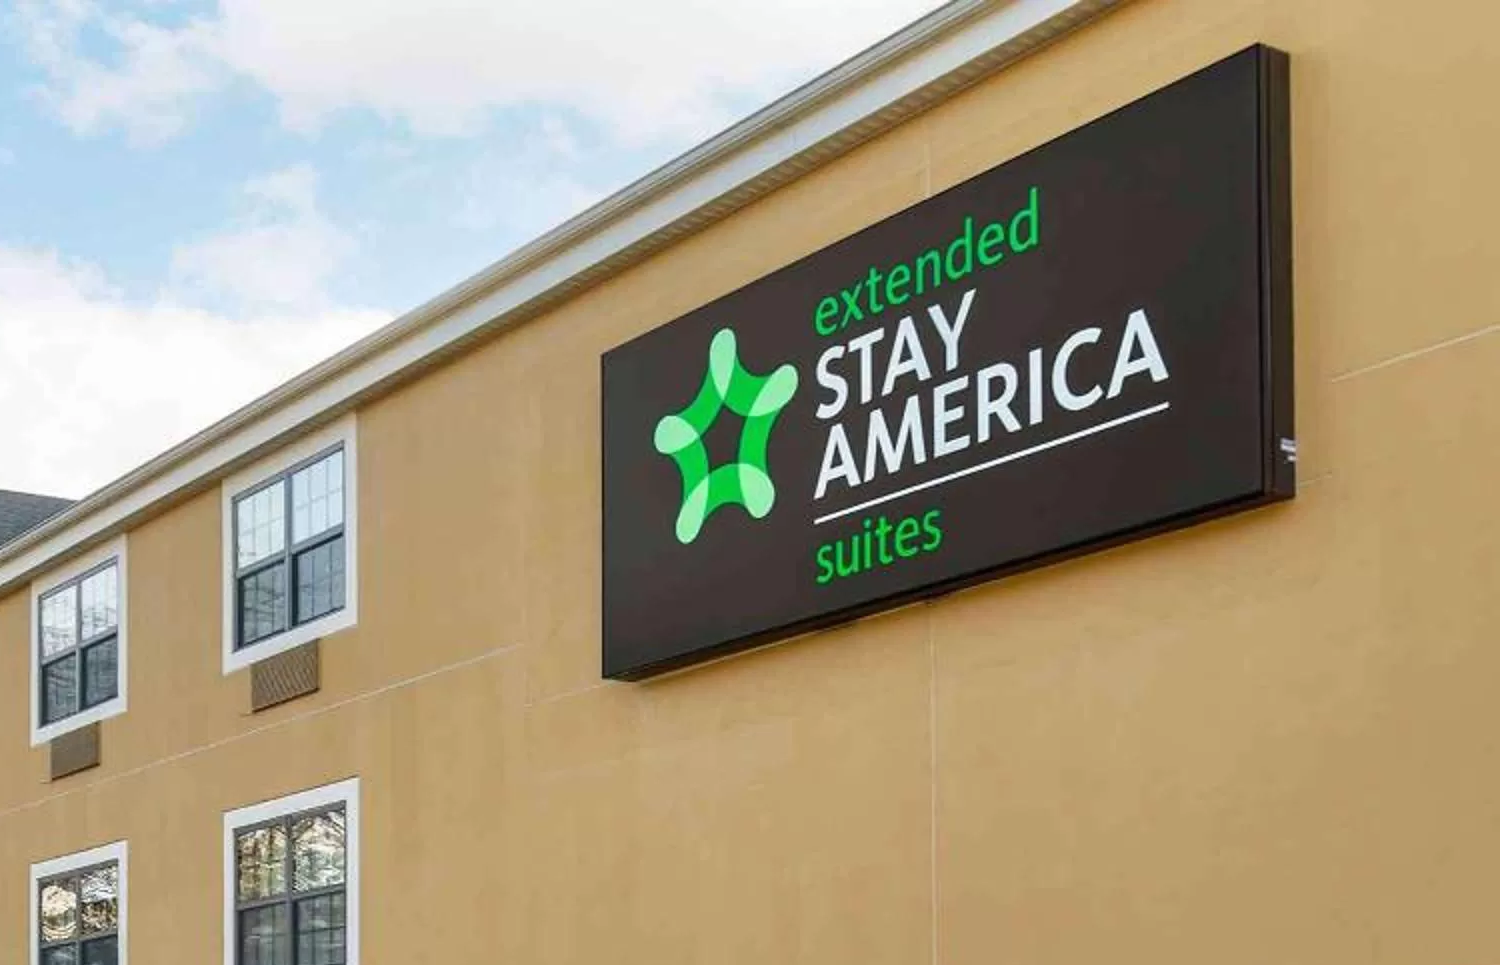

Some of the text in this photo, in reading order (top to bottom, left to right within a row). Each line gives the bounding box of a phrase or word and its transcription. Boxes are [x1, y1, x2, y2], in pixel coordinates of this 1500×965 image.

[815, 187, 1039, 336] extended
[813, 308, 1170, 500] AMERICA
[815, 288, 977, 420] STAY
[816, 510, 942, 584] suites
